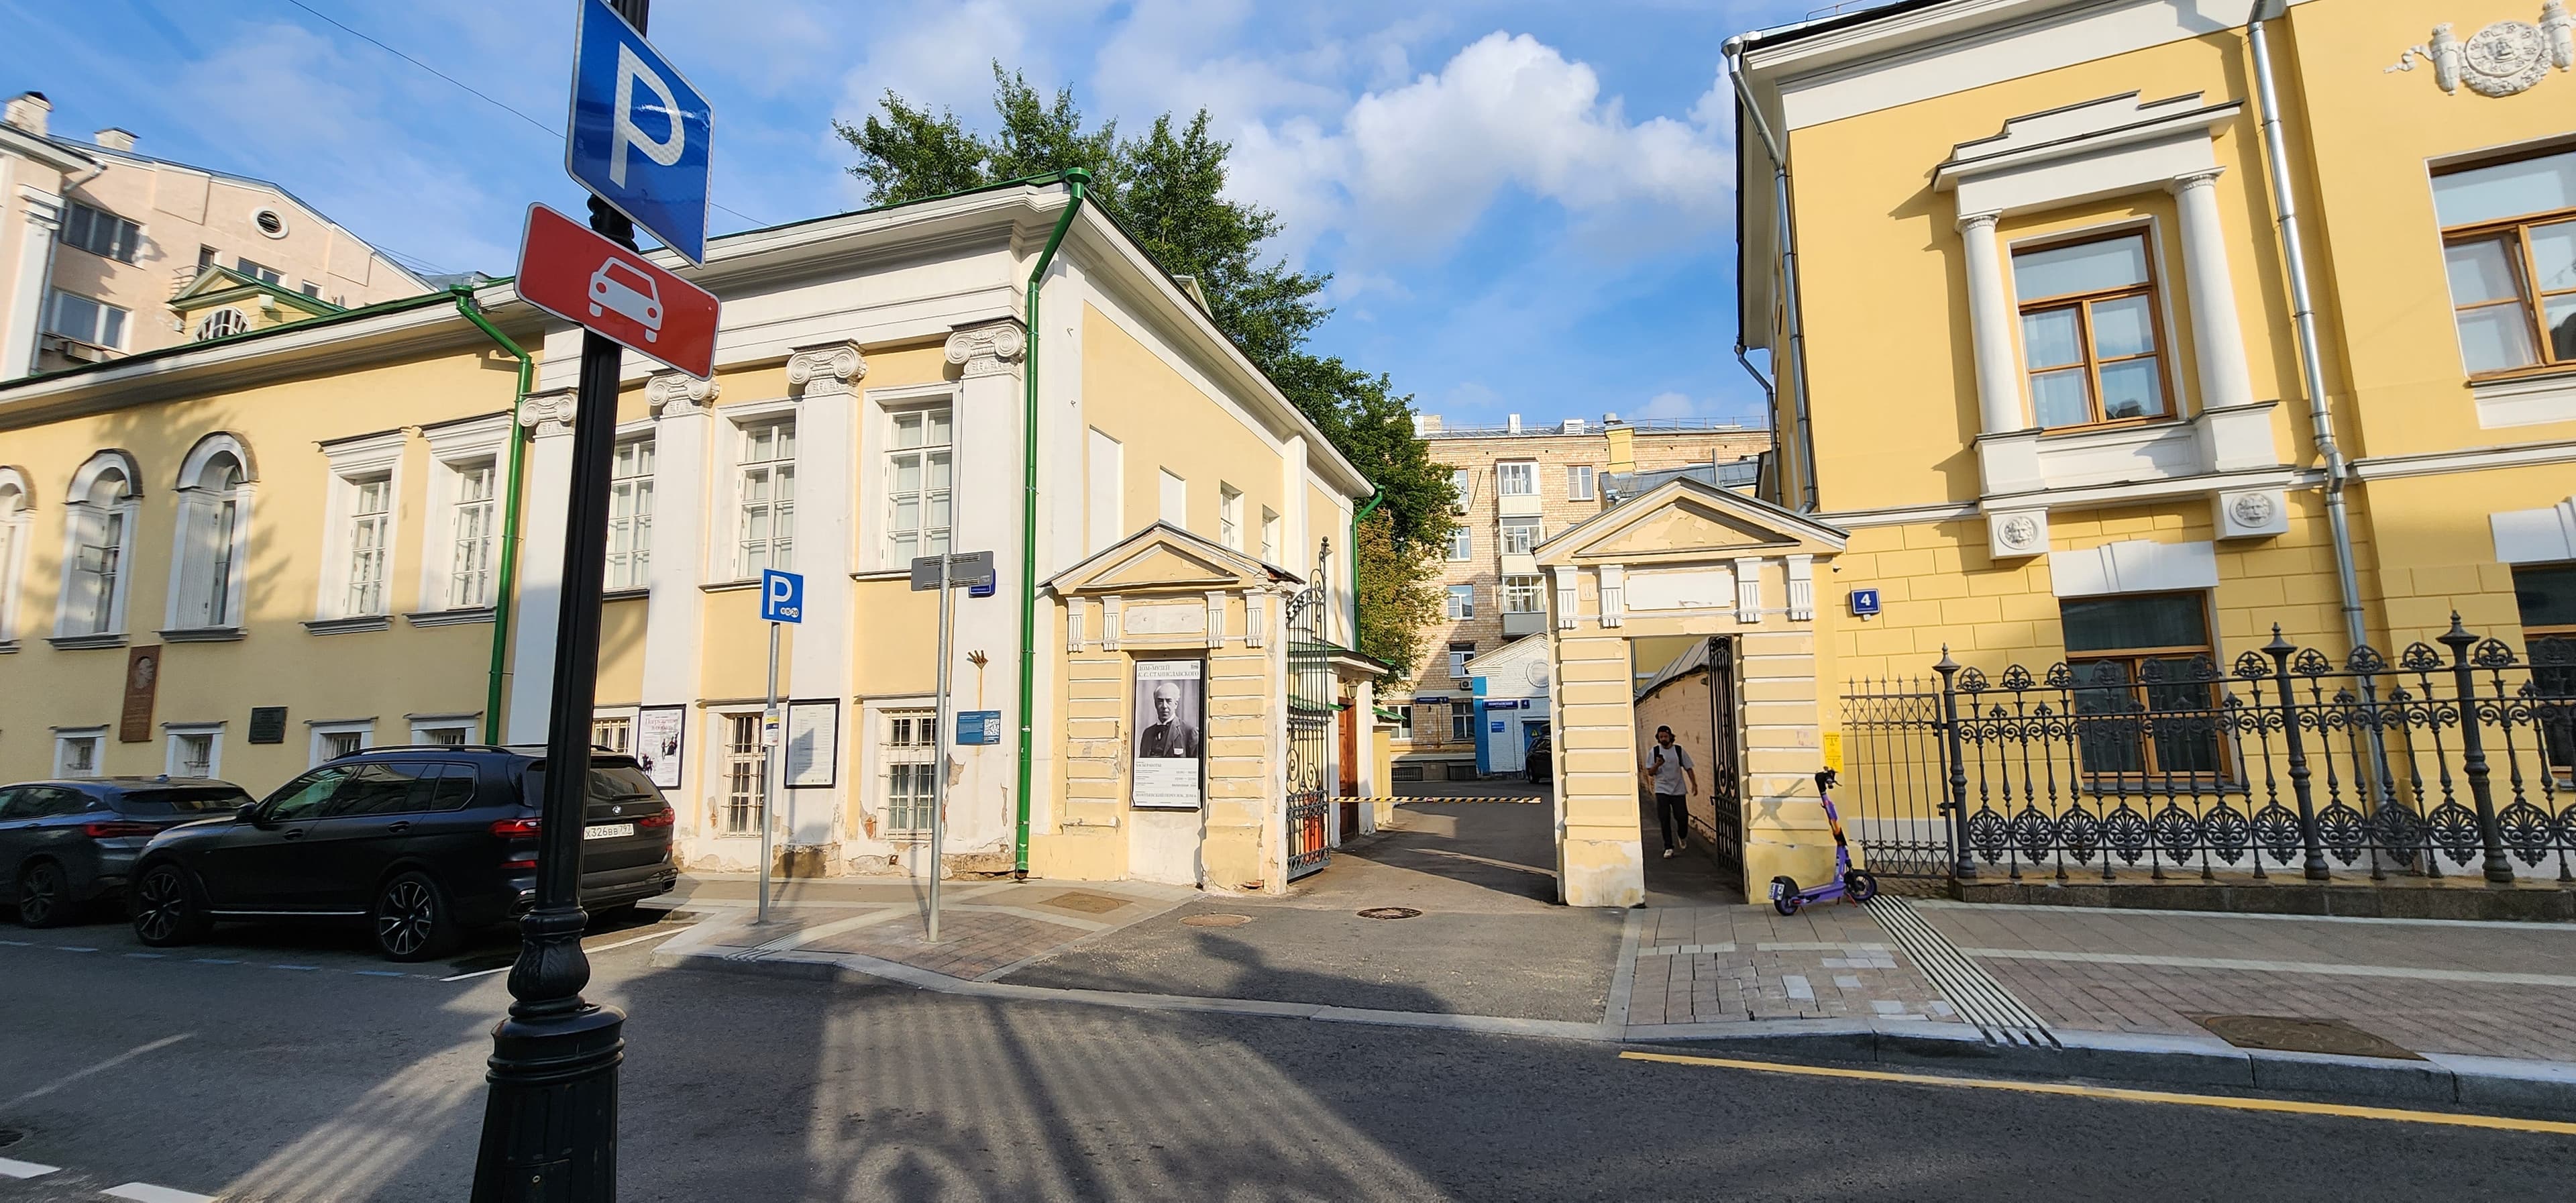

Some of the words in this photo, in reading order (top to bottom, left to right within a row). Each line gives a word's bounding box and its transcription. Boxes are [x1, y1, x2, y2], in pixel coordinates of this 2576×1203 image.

[609, 40, 685, 190] P
[769, 575, 792, 615] P
[1860, 593, 1872, 606] 4
[619, 825, 631, 833] 797
